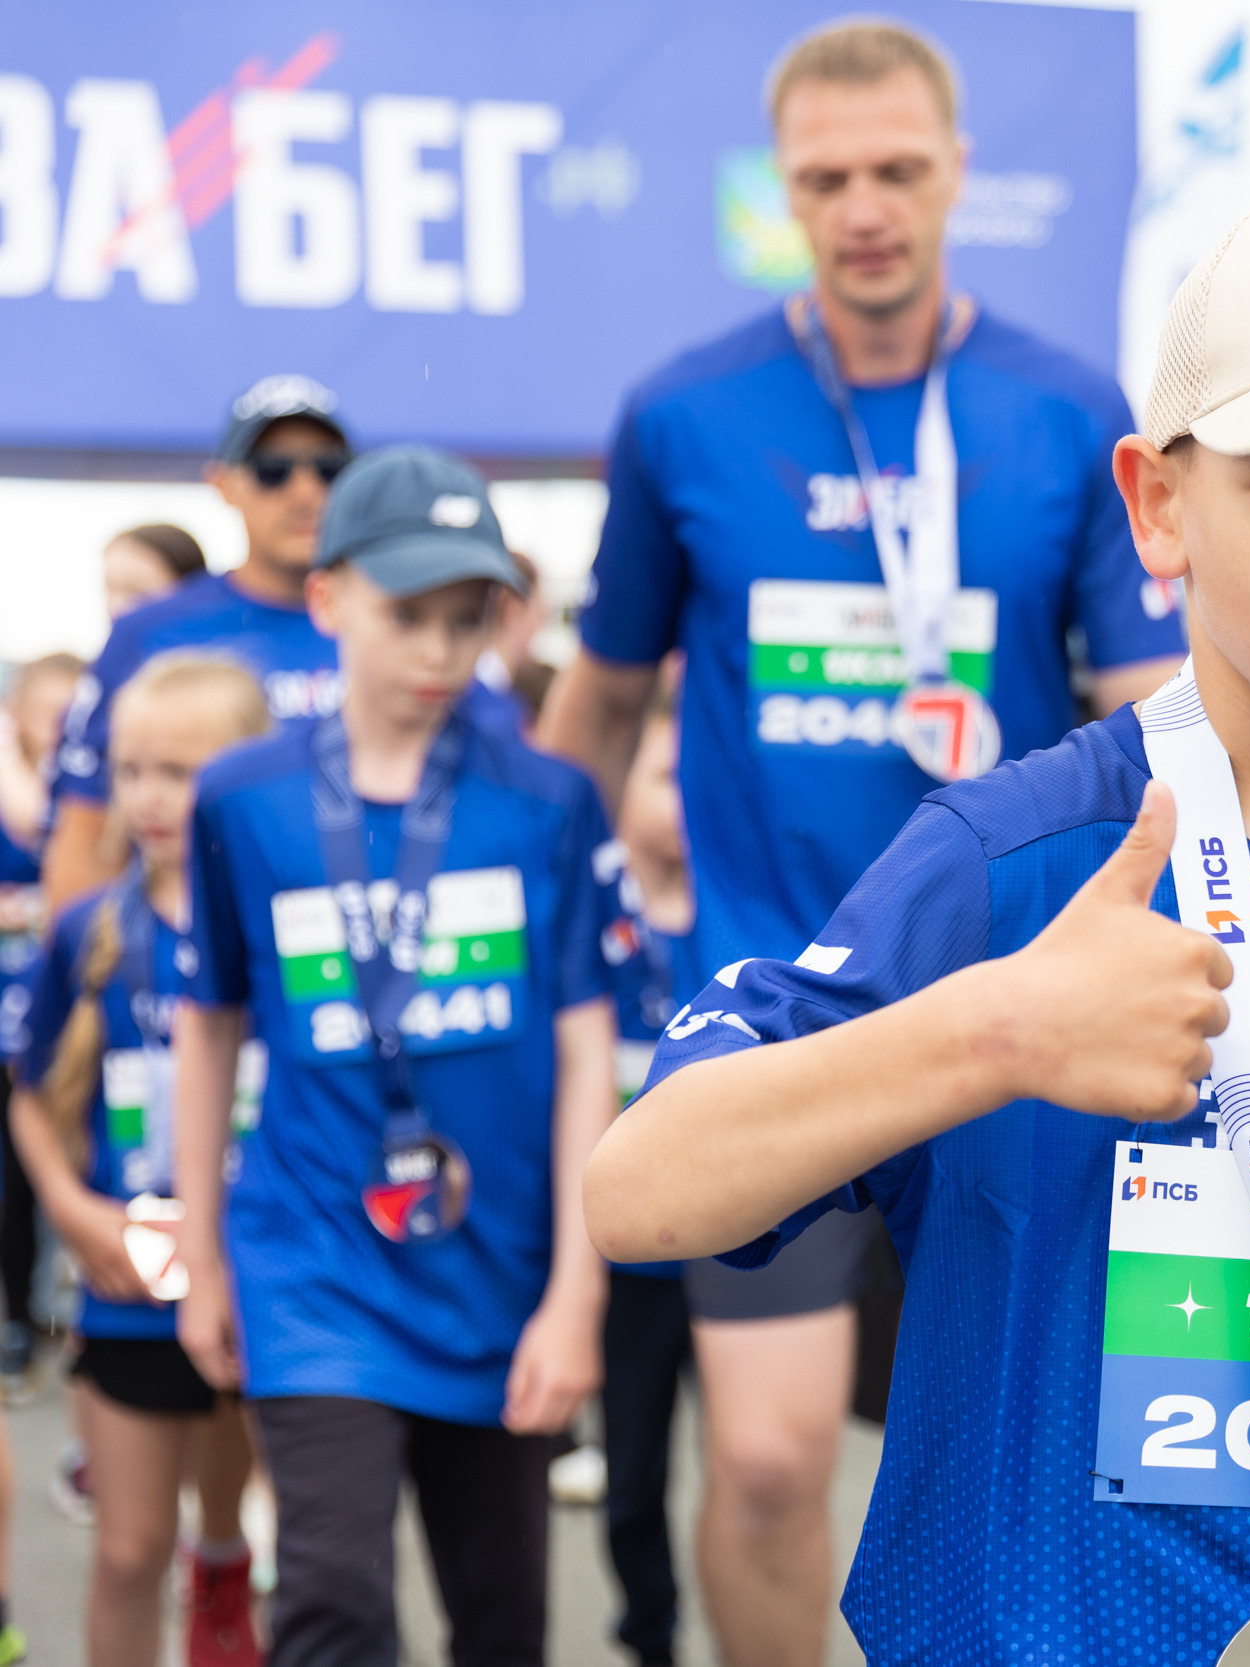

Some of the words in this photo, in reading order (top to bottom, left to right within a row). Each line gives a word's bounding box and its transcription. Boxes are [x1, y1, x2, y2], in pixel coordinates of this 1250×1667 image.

[230, 88, 565, 316] БЕГ
[757, 694, 910, 747] 204
[1199, 837, 1233, 900] ПСБ
[1152, 1181, 1198, 1202] ПСБ
